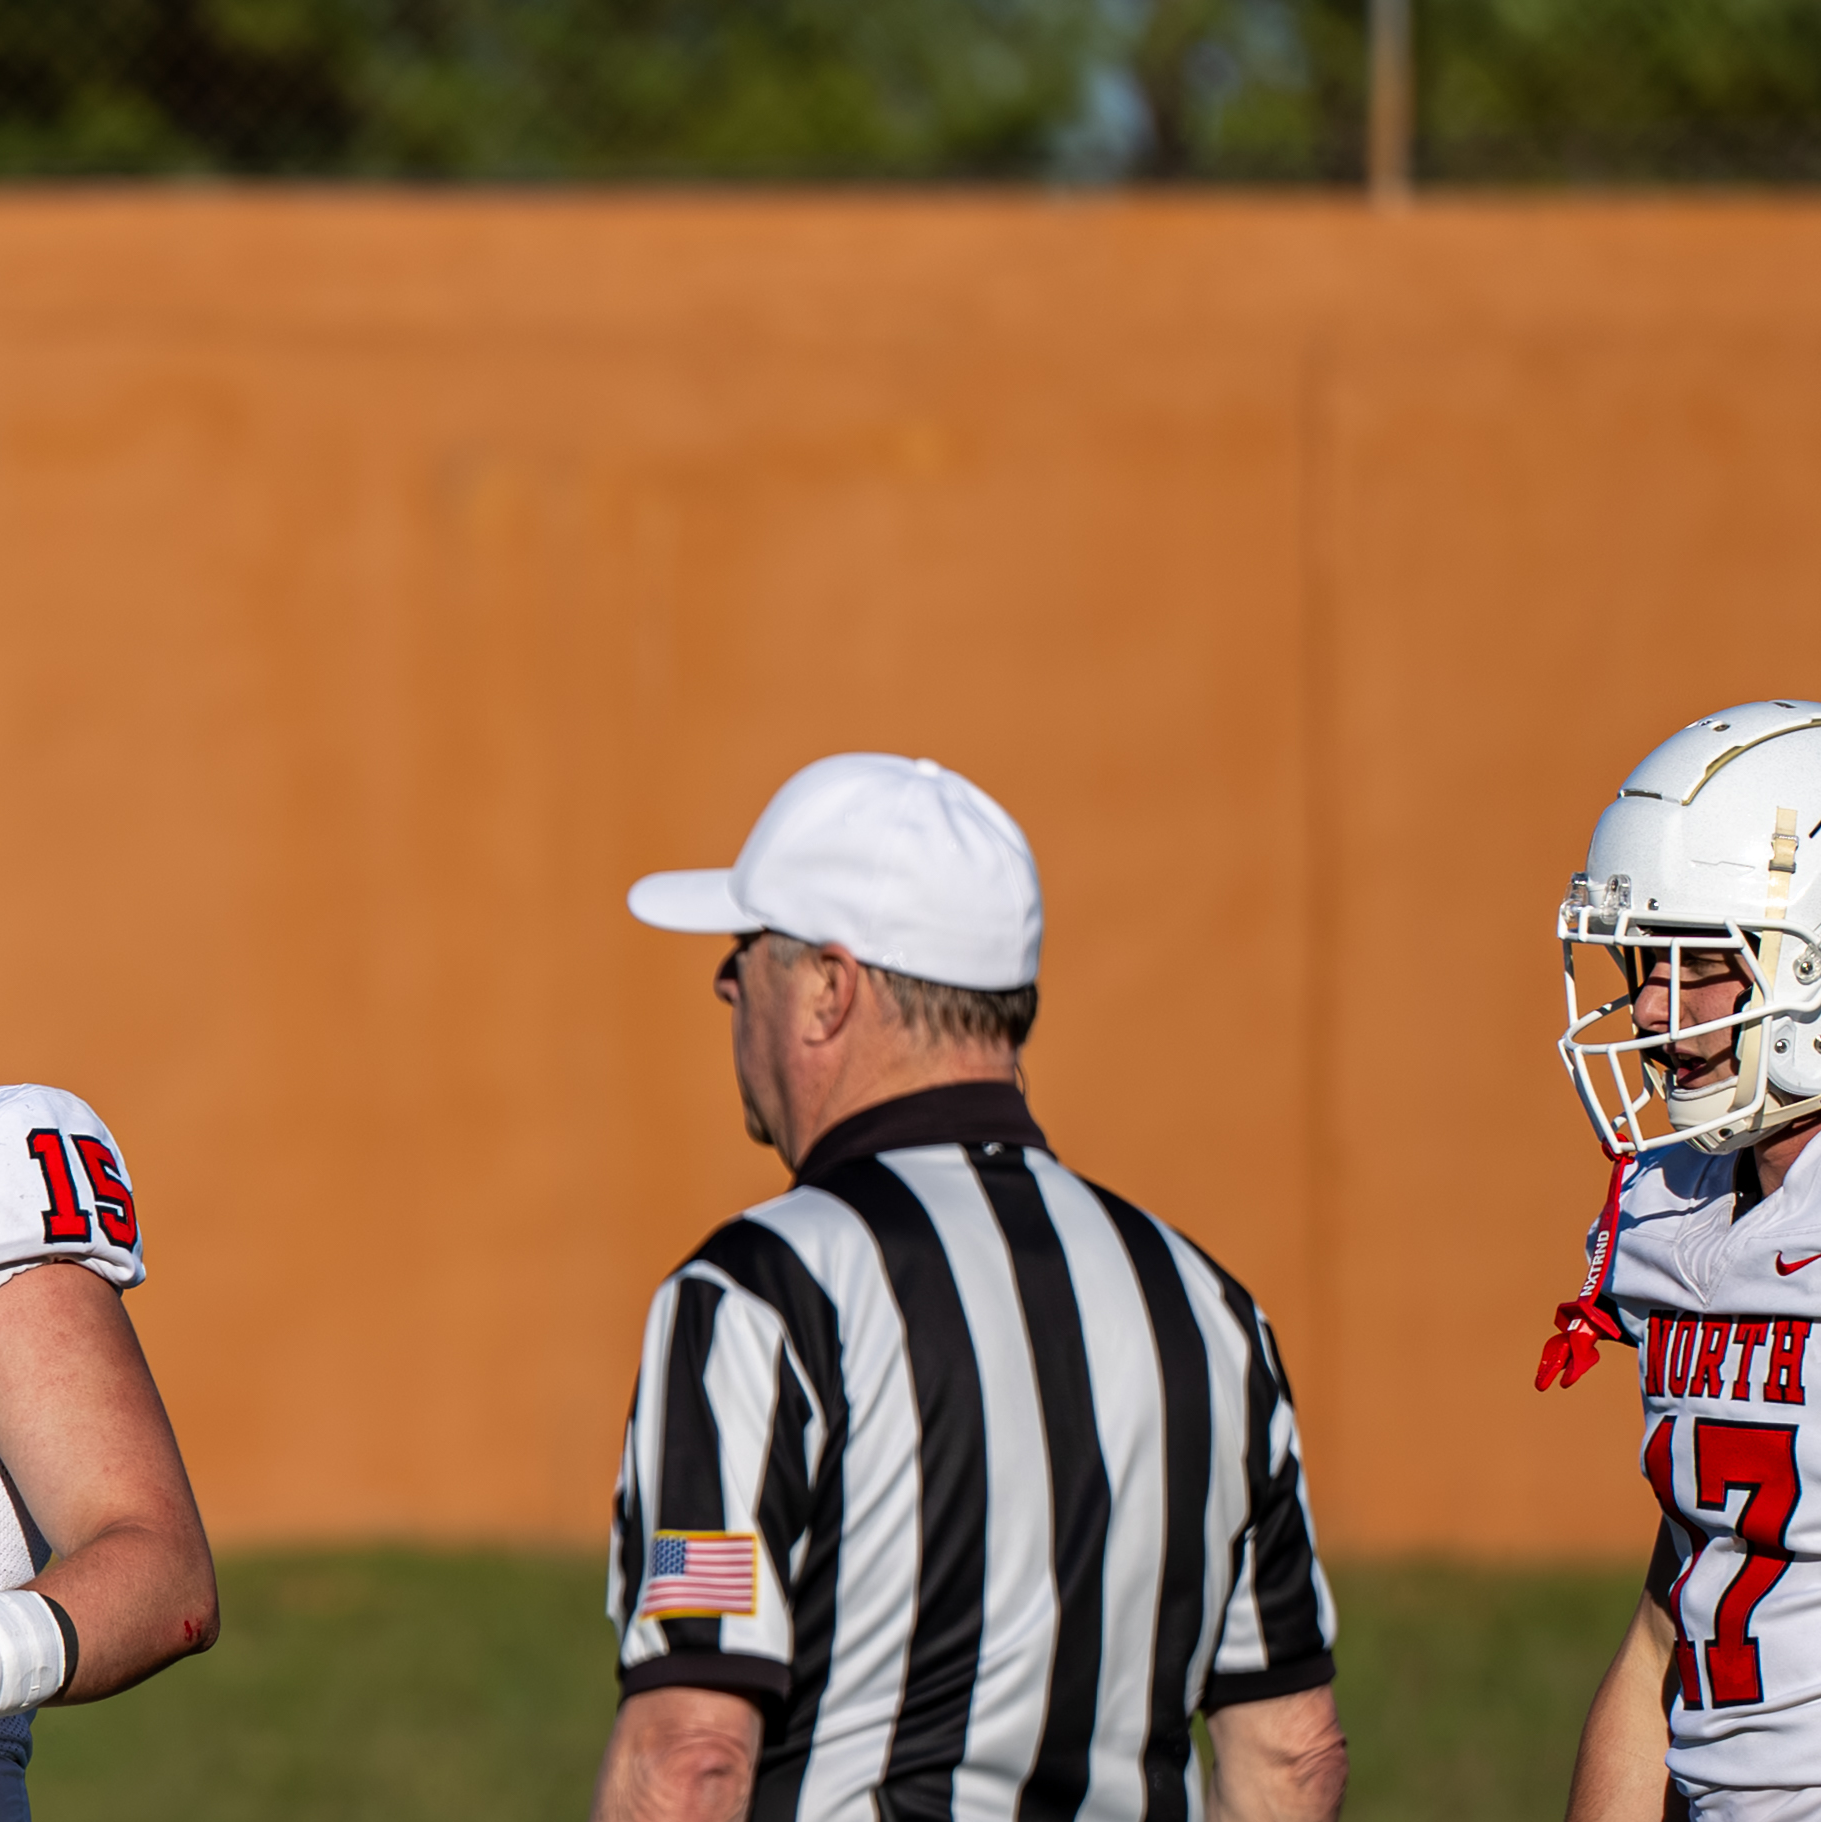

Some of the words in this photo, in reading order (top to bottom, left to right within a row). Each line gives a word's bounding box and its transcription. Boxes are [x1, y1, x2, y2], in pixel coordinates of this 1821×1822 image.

[26, 1128, 138, 1254] 15
[1580, 1230, 1610, 1297] NXTRND
[1644, 1309, 1814, 1406] NORTH
